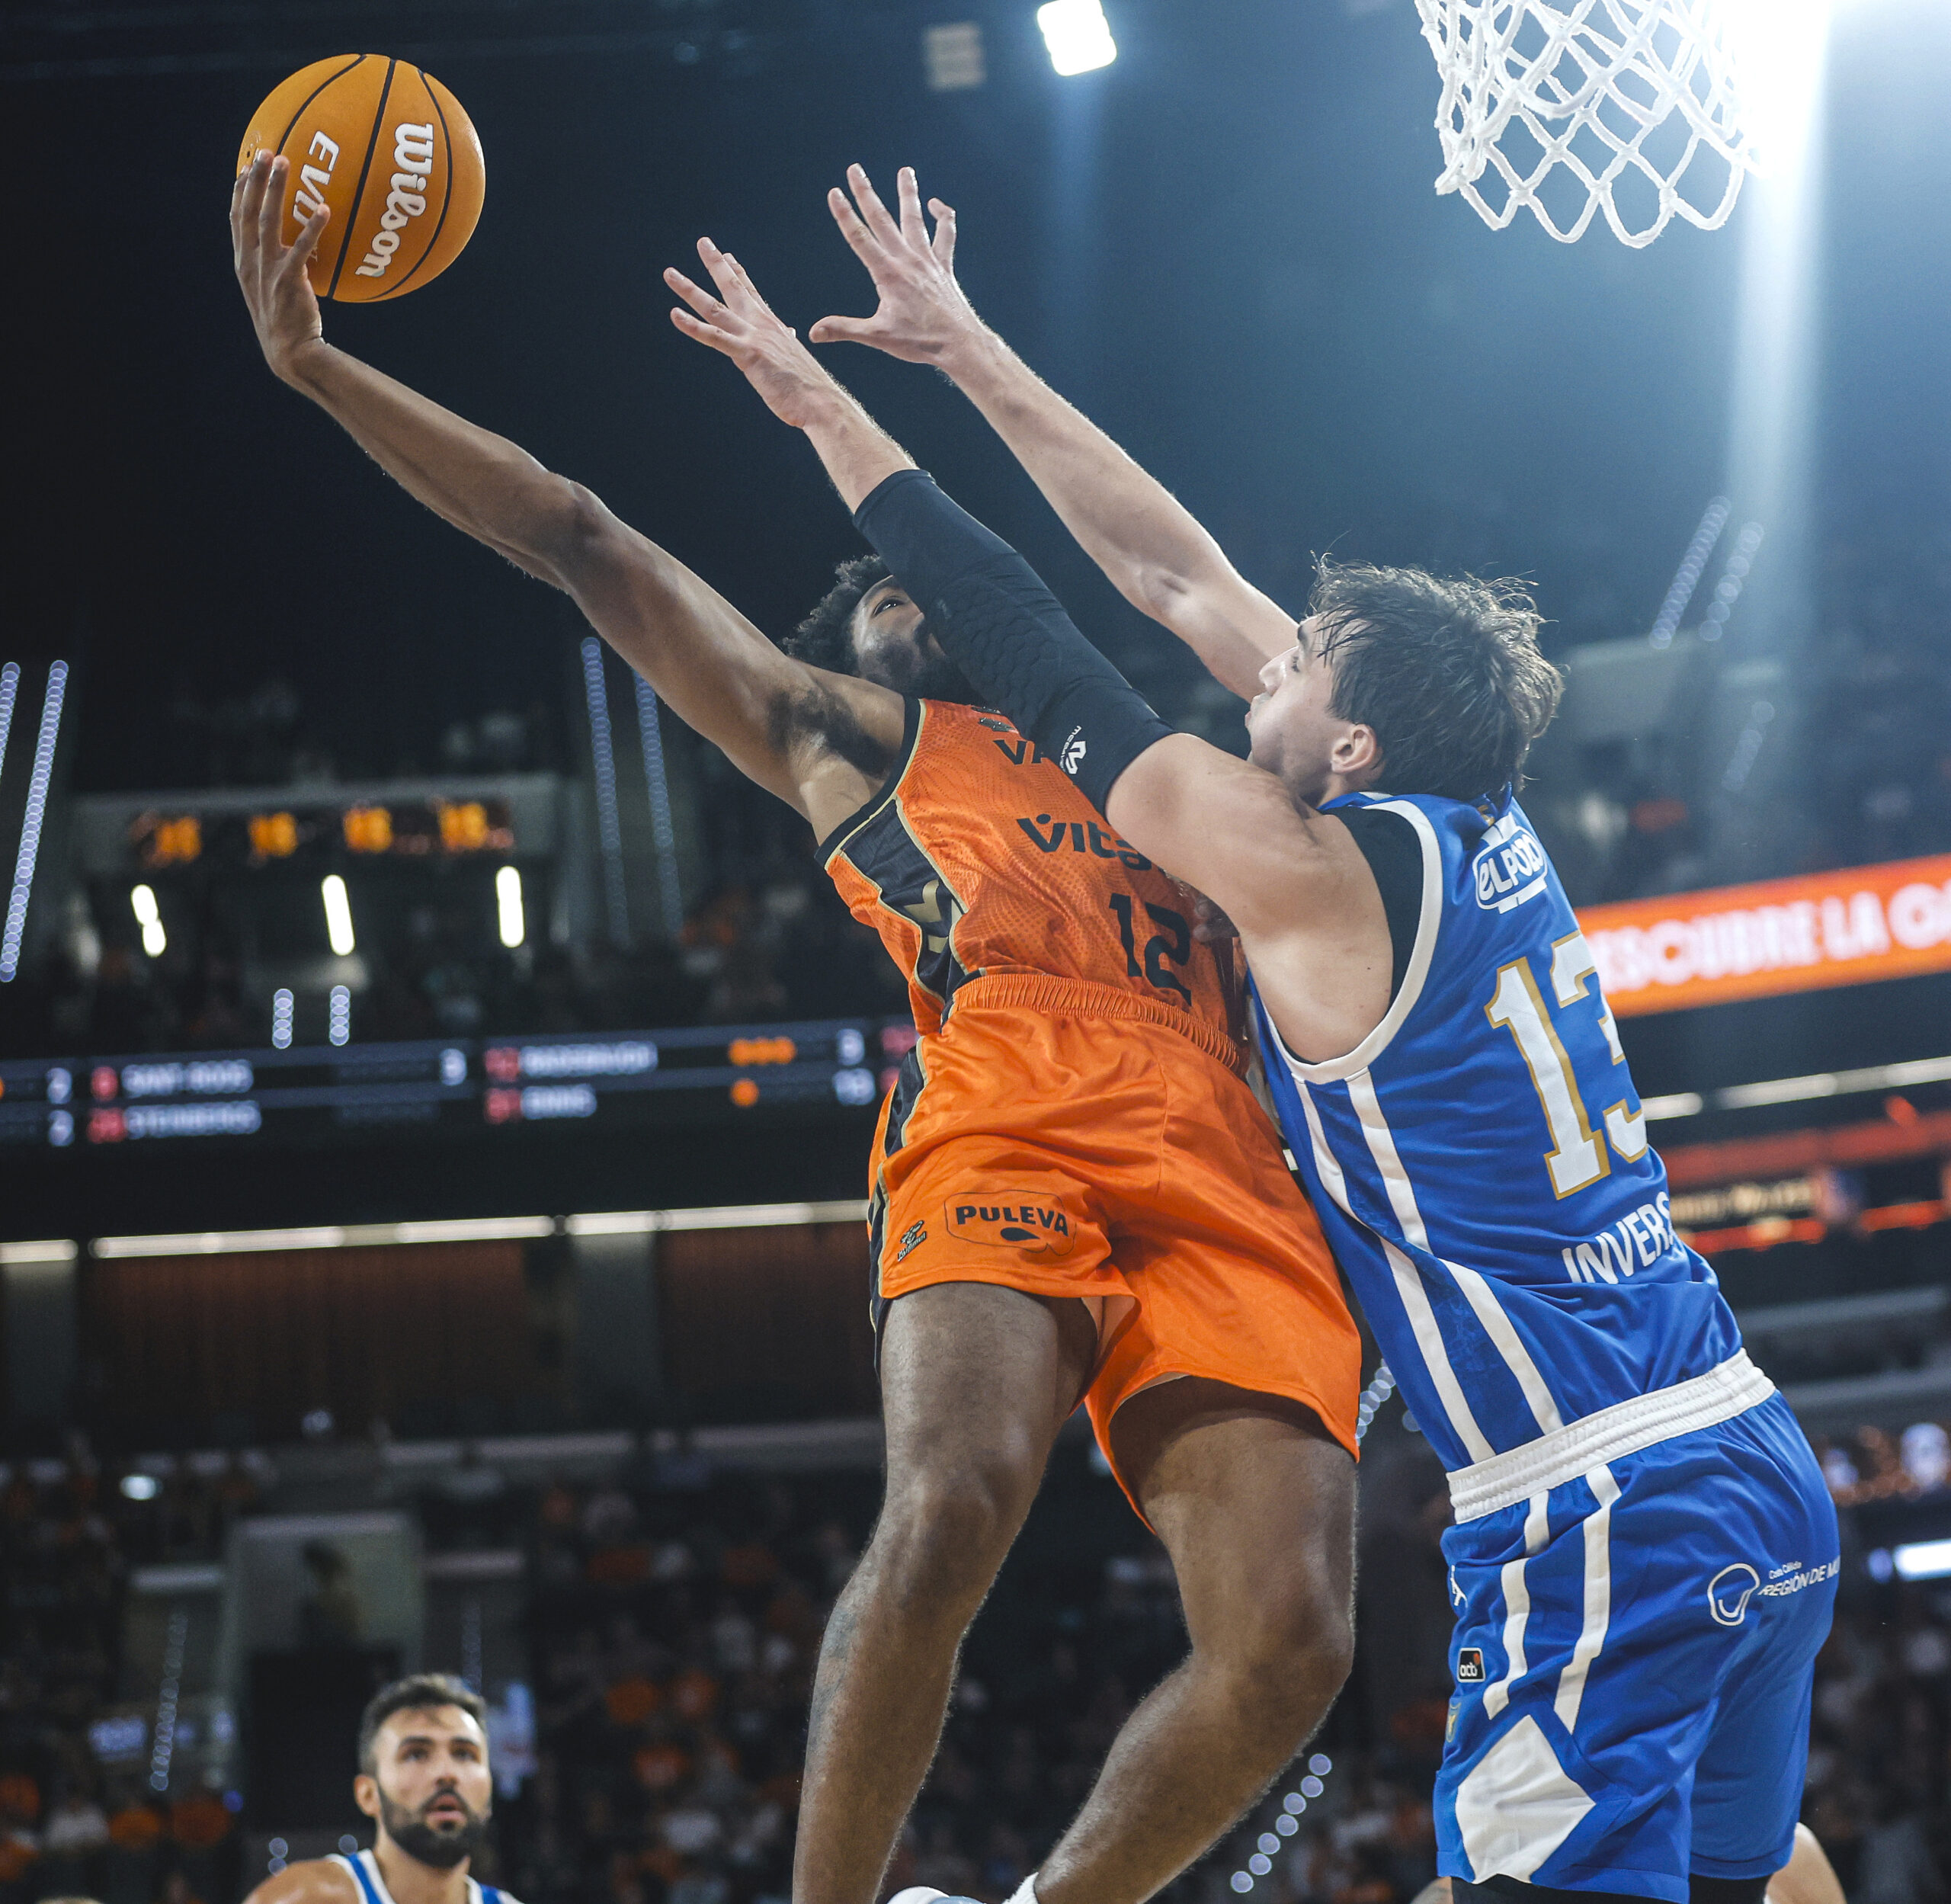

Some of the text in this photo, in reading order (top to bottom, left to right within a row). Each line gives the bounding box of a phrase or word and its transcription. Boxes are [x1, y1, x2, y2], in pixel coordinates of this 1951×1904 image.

[354, 122, 434, 277] Wilson
[1108, 893, 1192, 1006] 12
[1484, 930, 1648, 1200] 13
[956, 1206, 1068, 1237] PULEVA
[1808, 1564, 1827, 1585] DE
